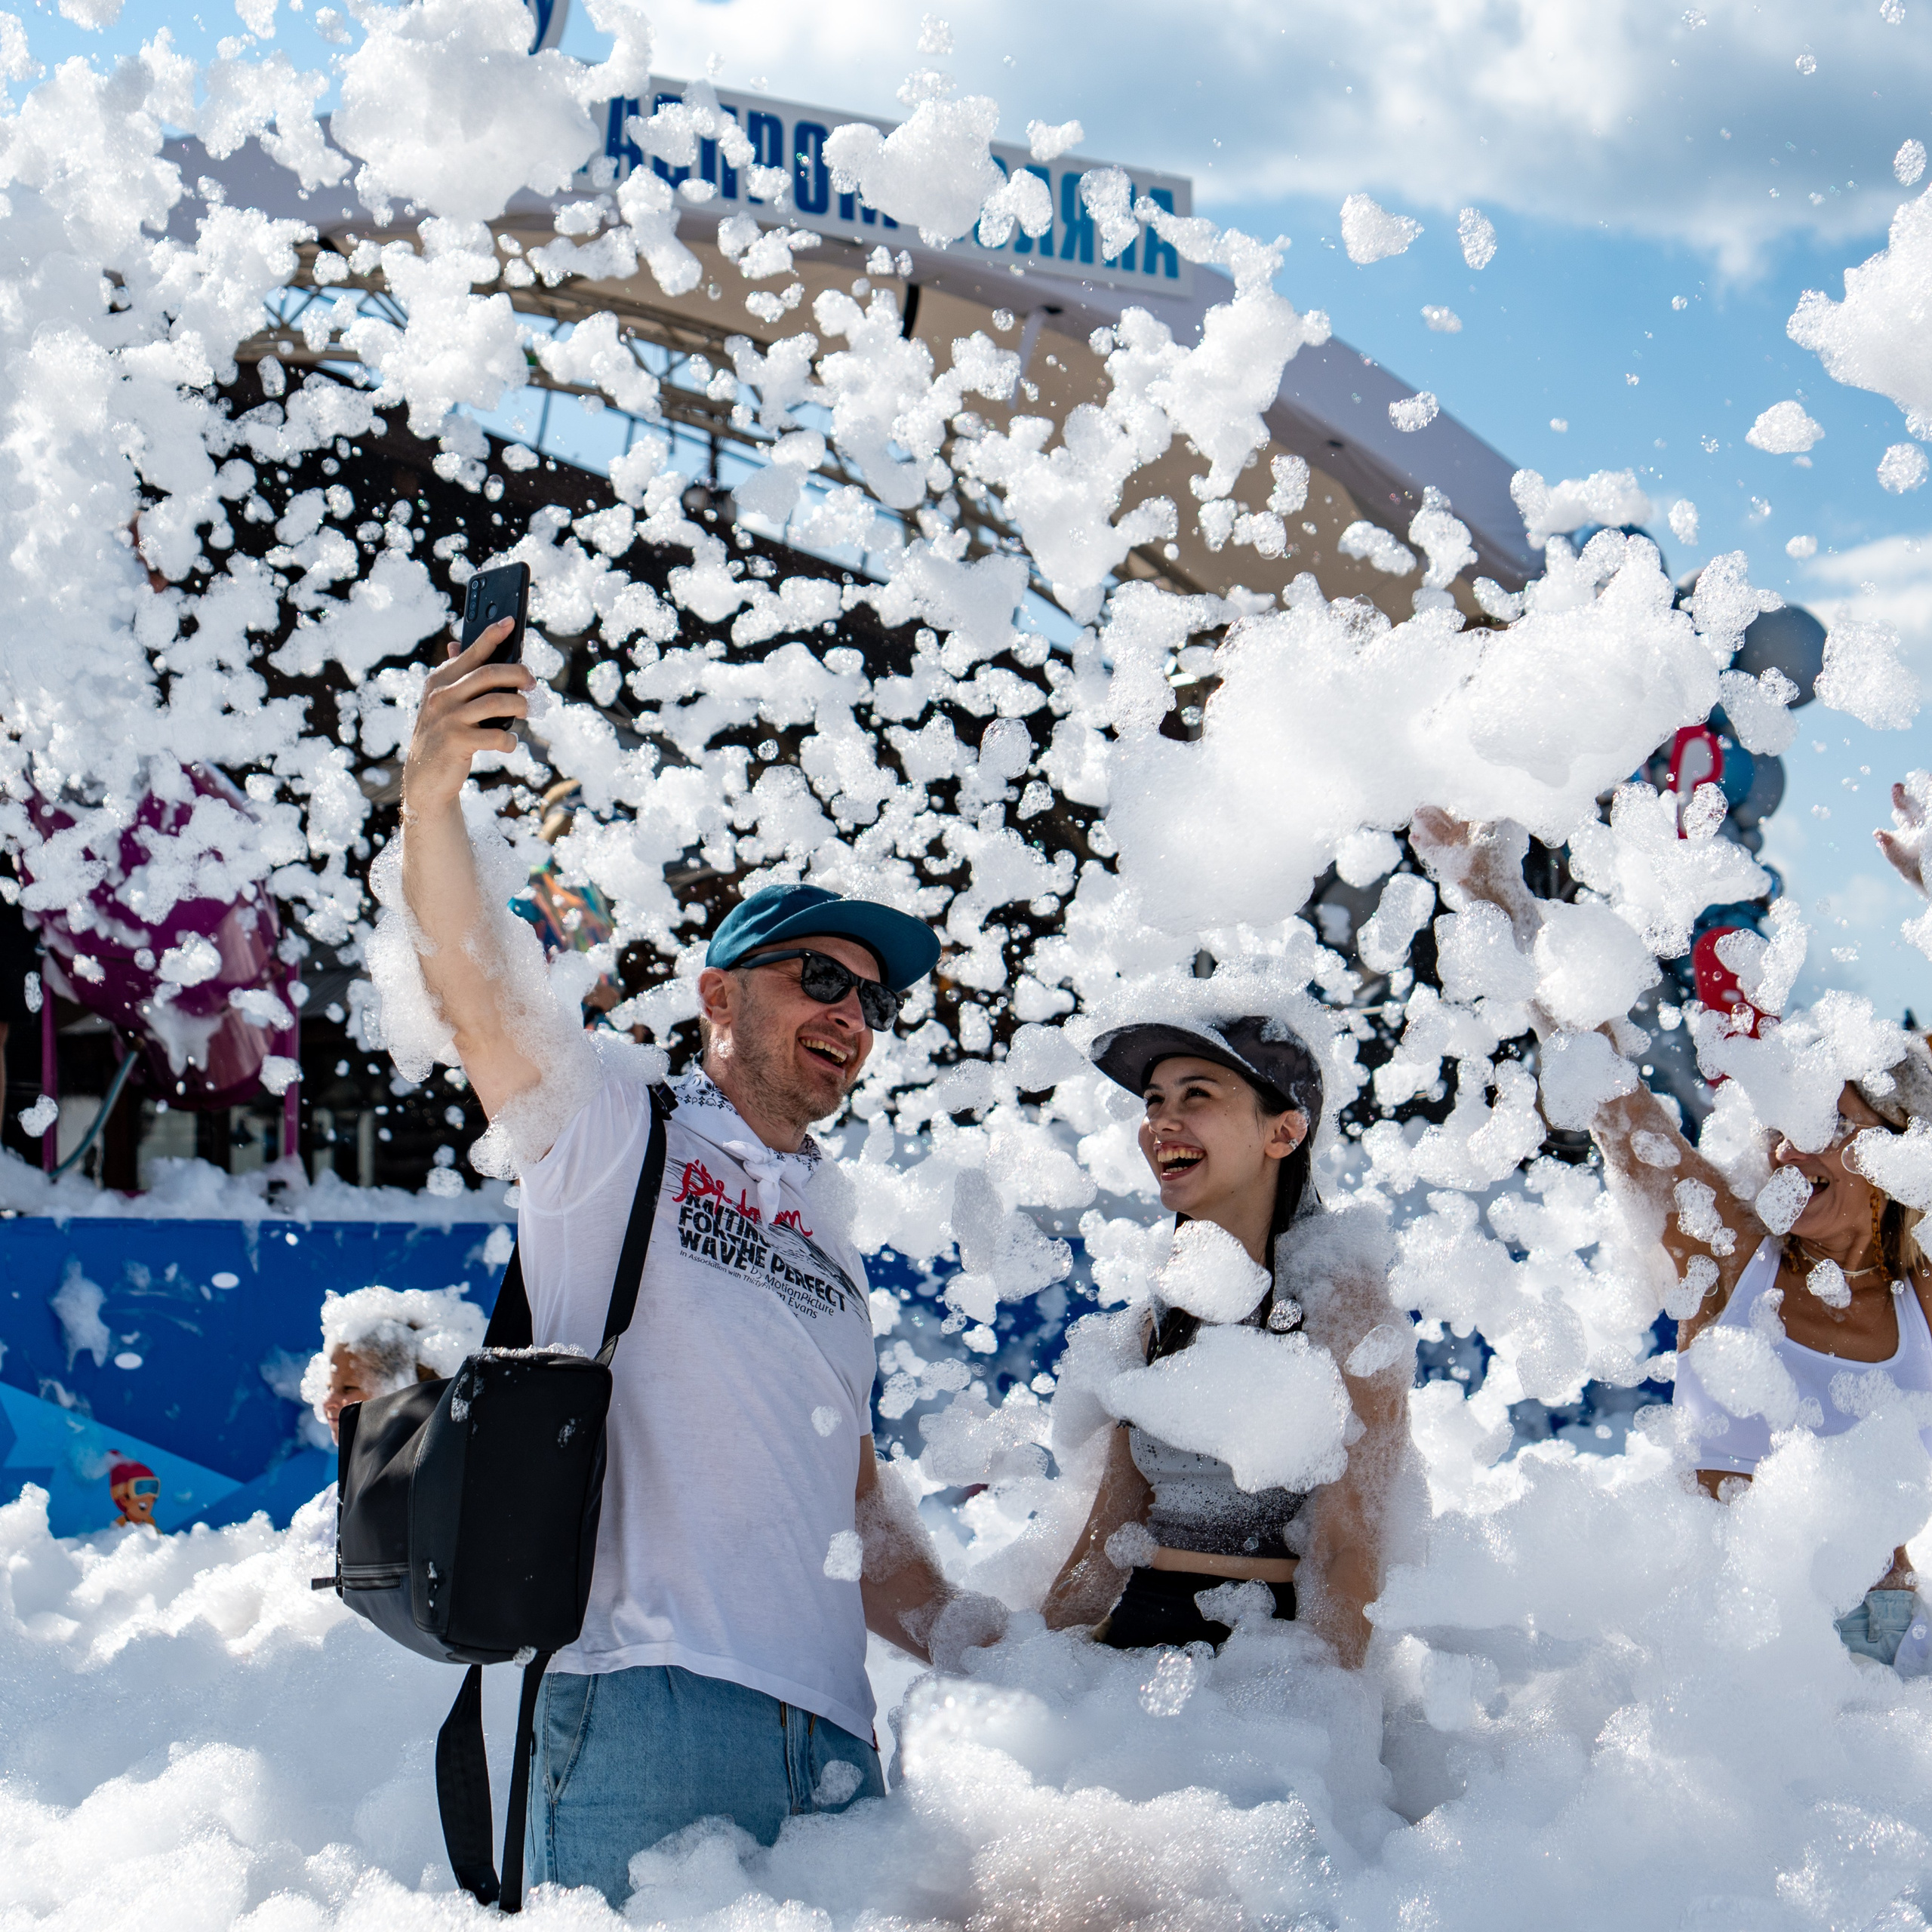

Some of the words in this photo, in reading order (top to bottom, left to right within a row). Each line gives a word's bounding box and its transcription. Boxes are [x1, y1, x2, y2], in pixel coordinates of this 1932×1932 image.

[677, 1226, 749, 1272] WAVE
[679, 1249, 688, 1258] In
[688, 1253, 728, 1273] Association
[728, 1269, 742, 1280] with
[787, 1296, 819, 1319] Evans
[770, 1252, 845, 1312] PERFECT
